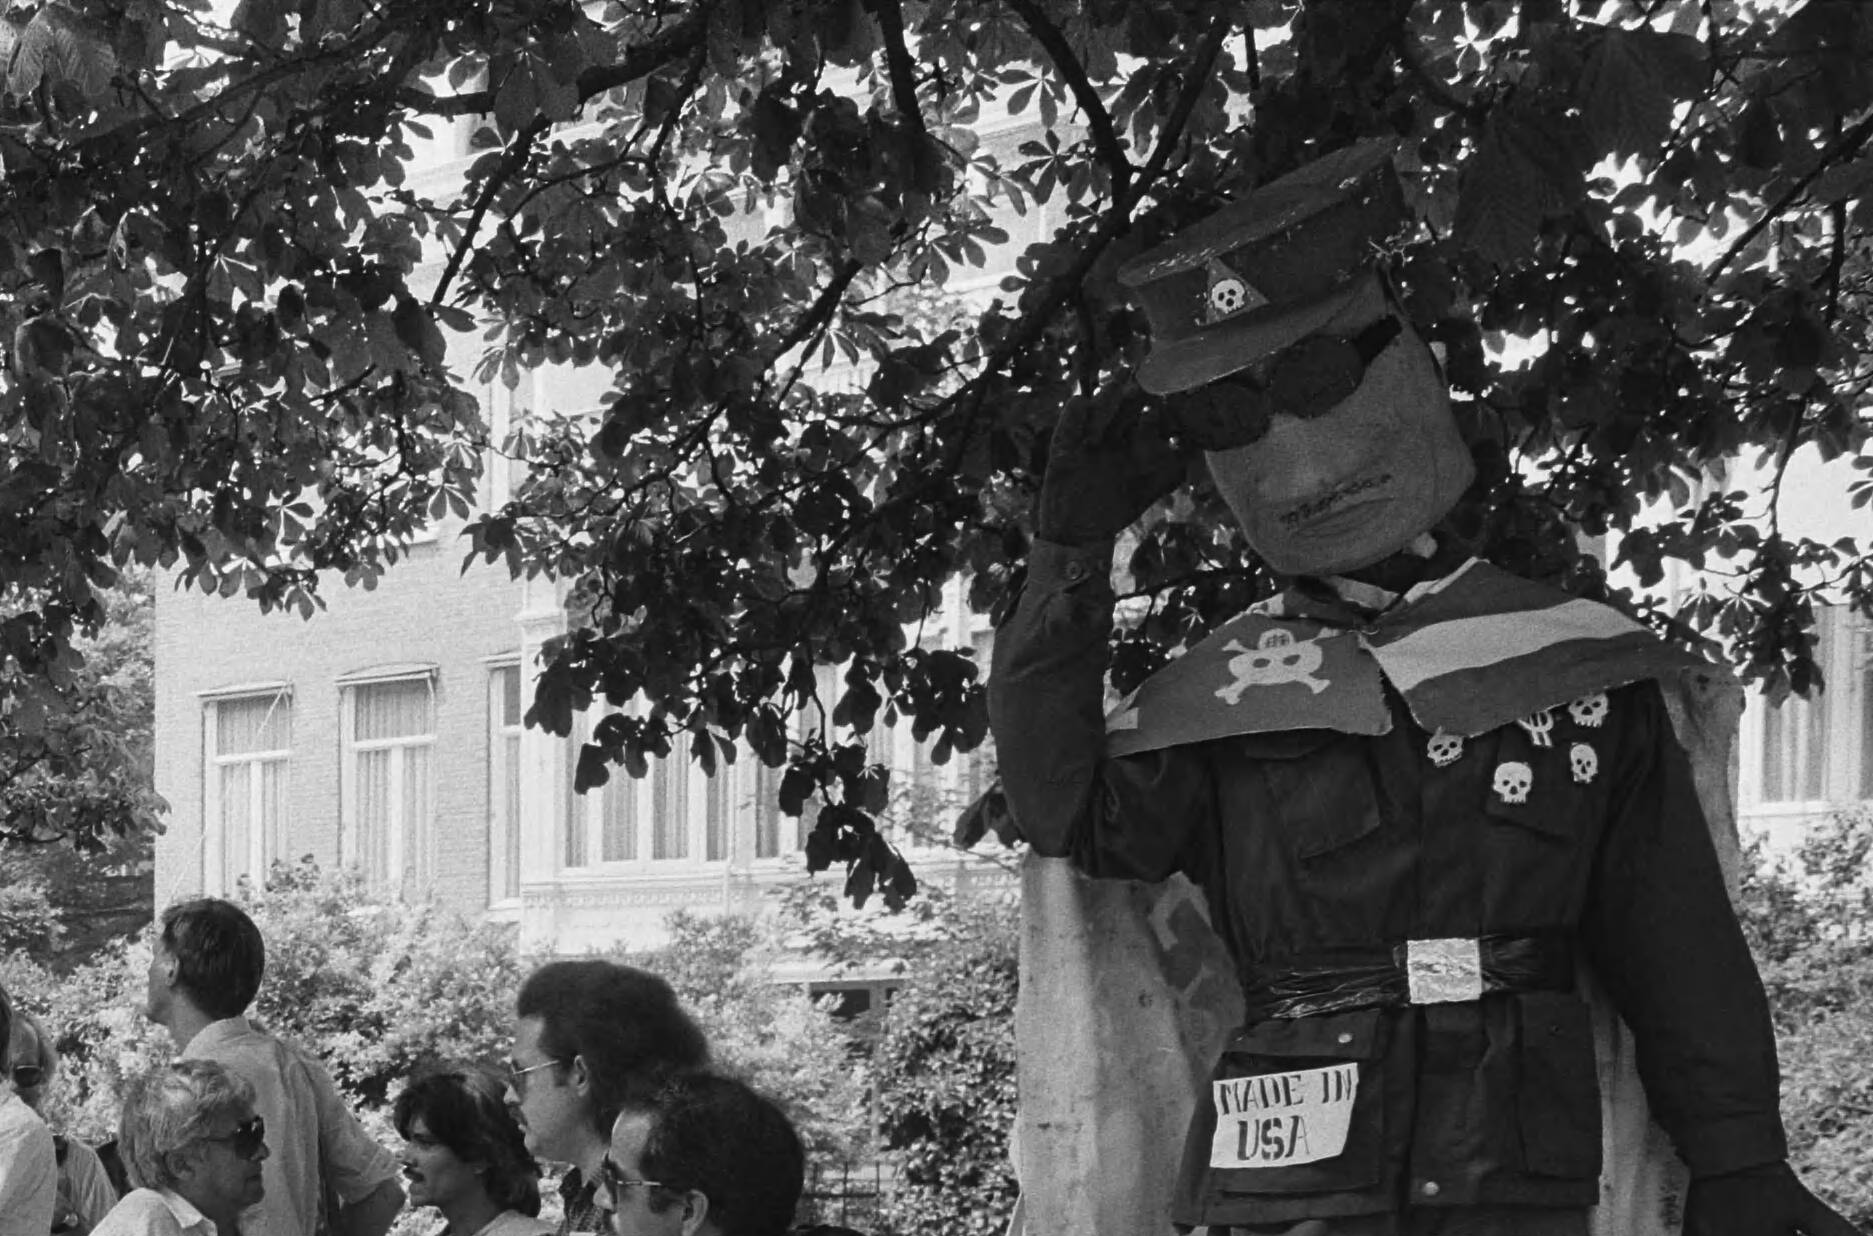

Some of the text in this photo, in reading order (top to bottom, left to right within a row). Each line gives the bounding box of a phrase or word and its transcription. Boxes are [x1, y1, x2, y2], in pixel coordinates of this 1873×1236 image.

[1218, 1068, 1352, 1116] MADE IN
[1237, 1114, 1310, 1161] USA
